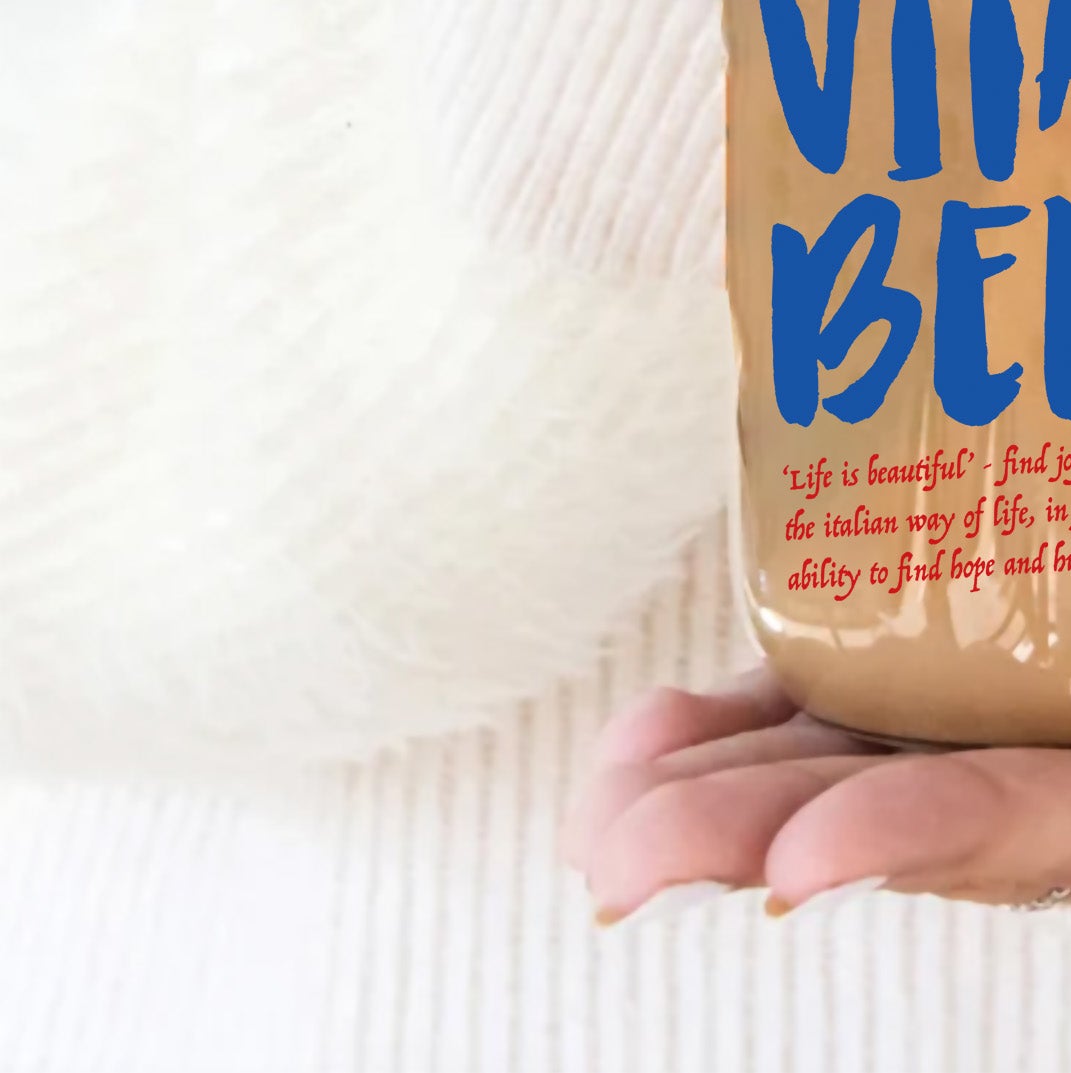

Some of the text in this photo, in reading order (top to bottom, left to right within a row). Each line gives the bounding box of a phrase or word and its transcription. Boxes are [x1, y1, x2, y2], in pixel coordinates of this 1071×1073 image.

[841, 461, 860, 487] is
[993, 441, 1052, 487] find
[785, 508, 816, 541] the
[823, 504, 899, 538] italian
[905, 512, 956, 545] way
[963, 496, 987, 539] of
[993, 493, 1036, 536] life,
[1045, 496, 1069, 523] in
[787, 557, 861, 602] ability
[869, 562, 889, 585] to
[888, 548, 945, 595] find
[950, 547, 996, 594] hope
[1004, 541, 1049, 576] and
